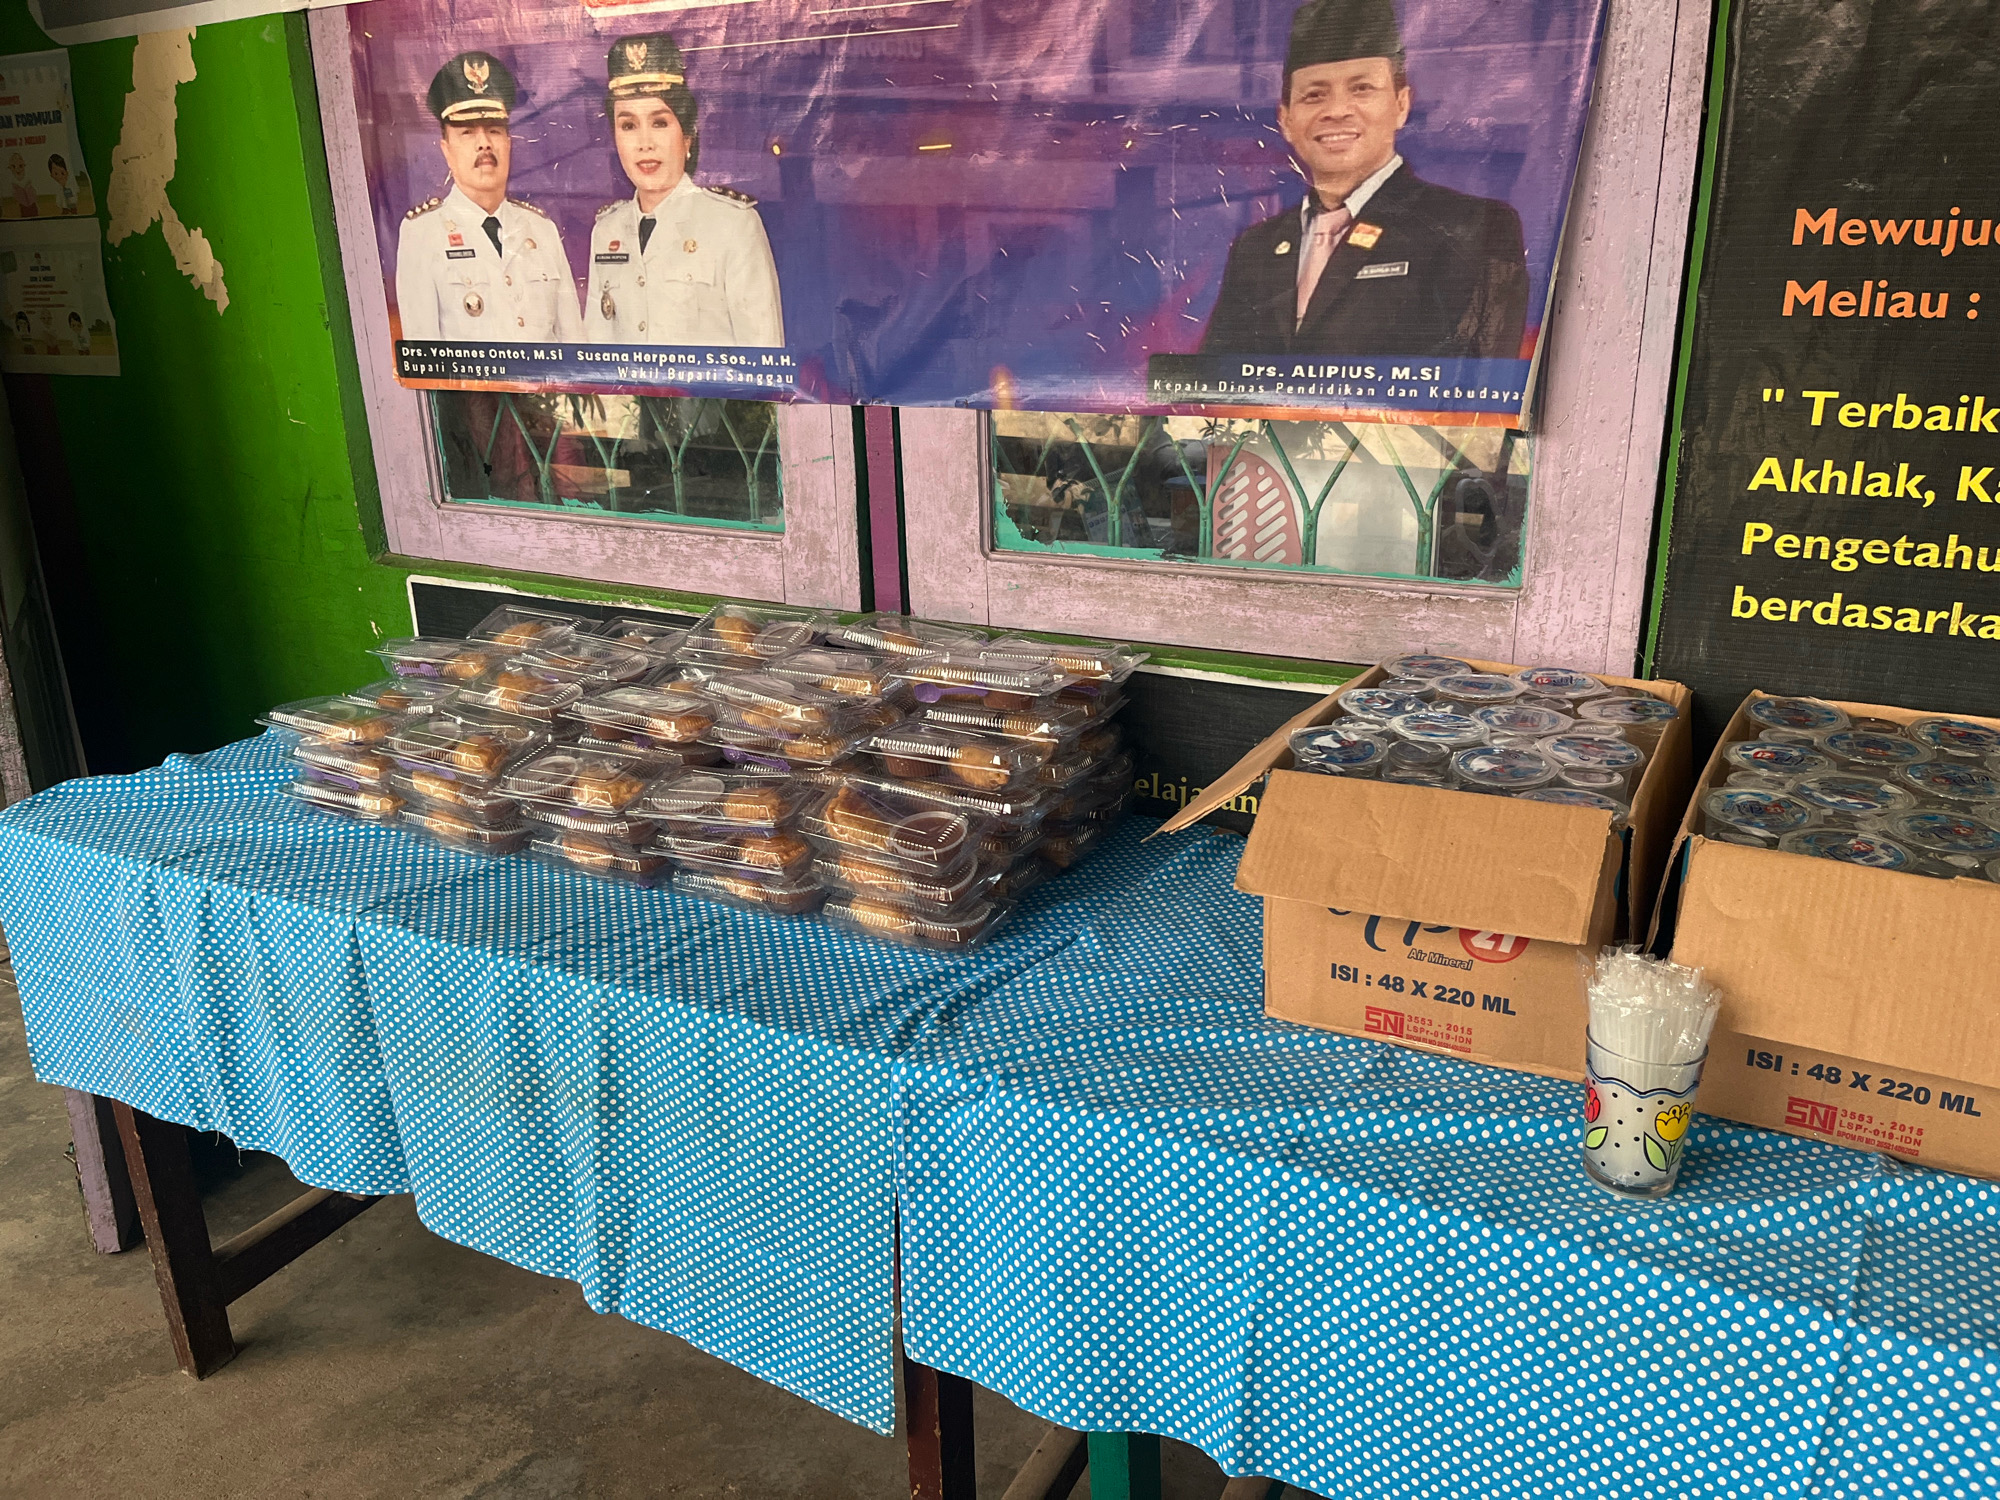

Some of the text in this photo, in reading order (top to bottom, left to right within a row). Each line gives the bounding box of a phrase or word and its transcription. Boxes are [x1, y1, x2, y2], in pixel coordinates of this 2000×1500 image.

[1782, 279, 1981, 320] Meliau :
[401, 346, 563, 361] Drs. Yohanes Ontot, M.Si
[576, 350, 797, 367] Susana Herpena, S.Sos., M.H.
[403, 362, 507, 377] Bupati Sanggau
[617, 366, 794, 386] Wakil Bupati Sanggau
[1241, 364, 1441, 382] Drs. ALIPIUS, M.Si
[1153, 380, 1208, 393] Kepala
[1218, 381, 1265, 394] Dinas
[1275, 382, 1375, 396] Pendidikan
[1387, 385, 1418, 398] dan
[1801, 390, 2000, 433] Terbaik
[1746, 457, 1936, 508] Akhlak,
[1731, 585, 2000, 640] berdasarka
[1408, 948, 1473, 971] Air Mineral
[1330, 963, 1517, 1016] ISI : 48 X 220 ML
[1364, 1005, 1405, 1037] SNI
[1406, 1014, 1433, 1027] 3553
[1445, 1023, 1473, 1036] 2015
[1406, 1023, 1473, 1045] LSPr-019-IDN
[1746, 1049, 1982, 1118] ISI : 48 X 220 ML
[1784, 1096, 1838, 1136] SNI
[1840, 1109, 1874, 1124] 3553
[1890, 1121, 1924, 1137] 2015
[1838, 1120, 1921, 1147] LSPr-019-IDN
